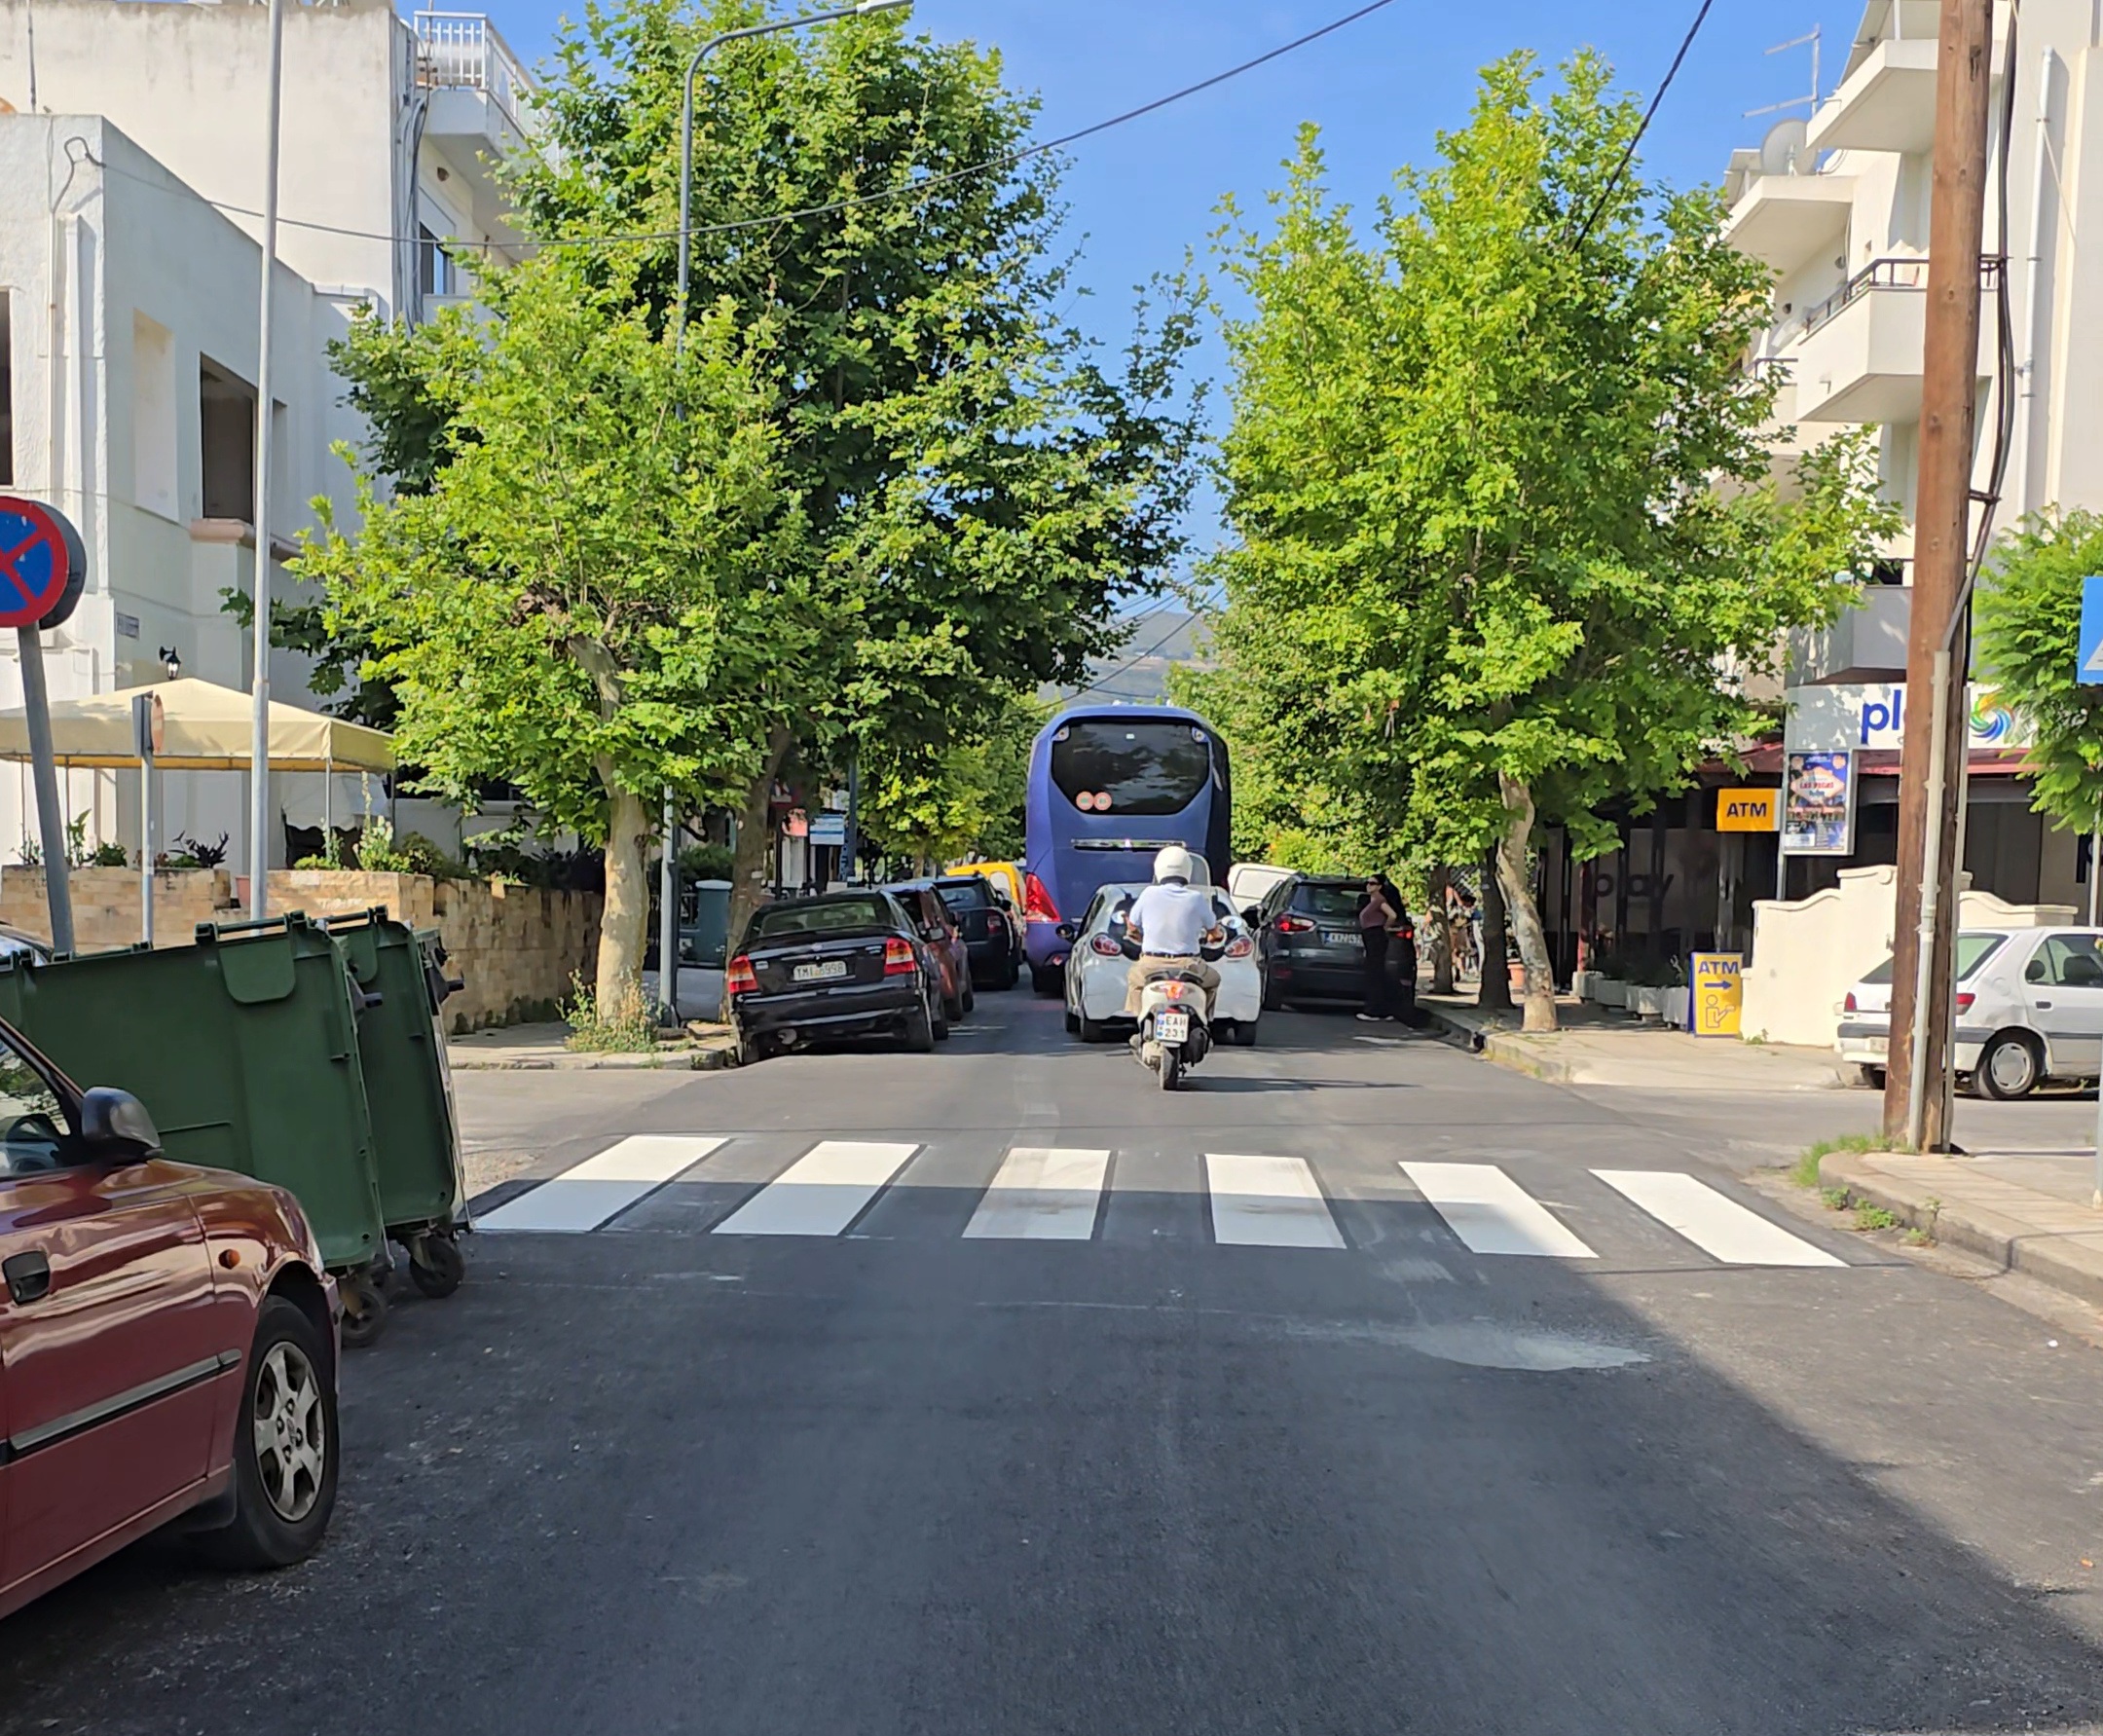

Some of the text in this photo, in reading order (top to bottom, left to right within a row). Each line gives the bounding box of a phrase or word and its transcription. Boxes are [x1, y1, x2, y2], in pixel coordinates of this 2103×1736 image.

[1861, 689, 1907, 745] pl
[1726, 802, 1767, 818] ATM
[1698, 961, 1739, 975] ATM
